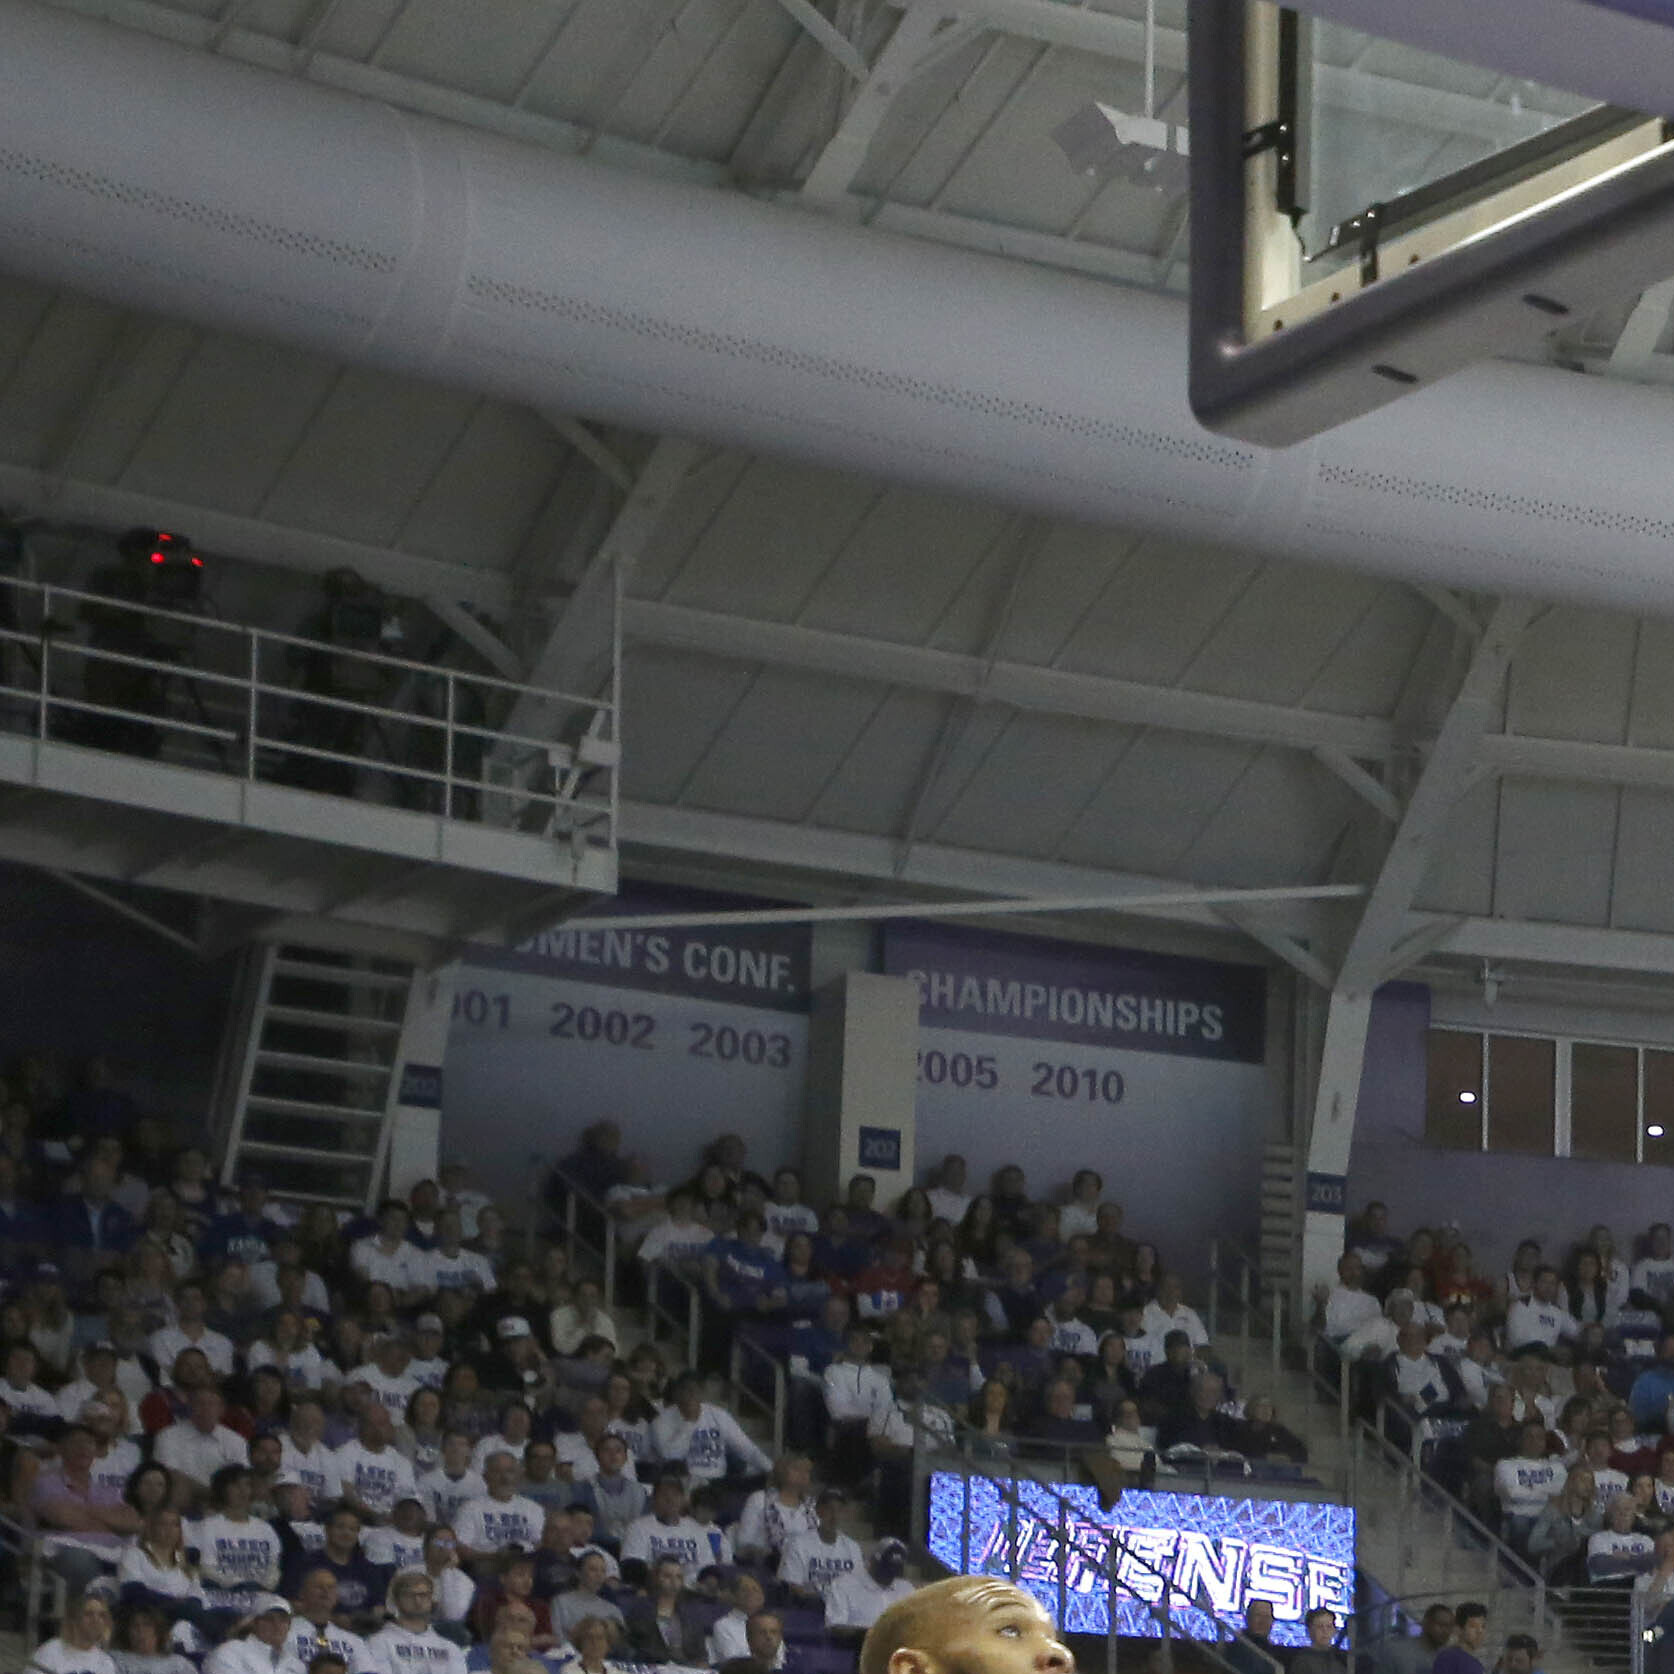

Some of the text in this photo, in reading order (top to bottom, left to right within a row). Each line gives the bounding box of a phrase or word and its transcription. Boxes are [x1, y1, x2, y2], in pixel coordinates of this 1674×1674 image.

[513, 929, 797, 993] MEN'S CONF.
[549, 1001, 657, 1051] 2002
[687, 1021, 792, 1069] 2003
[917, 1050, 1124, 1104] 005 2010
